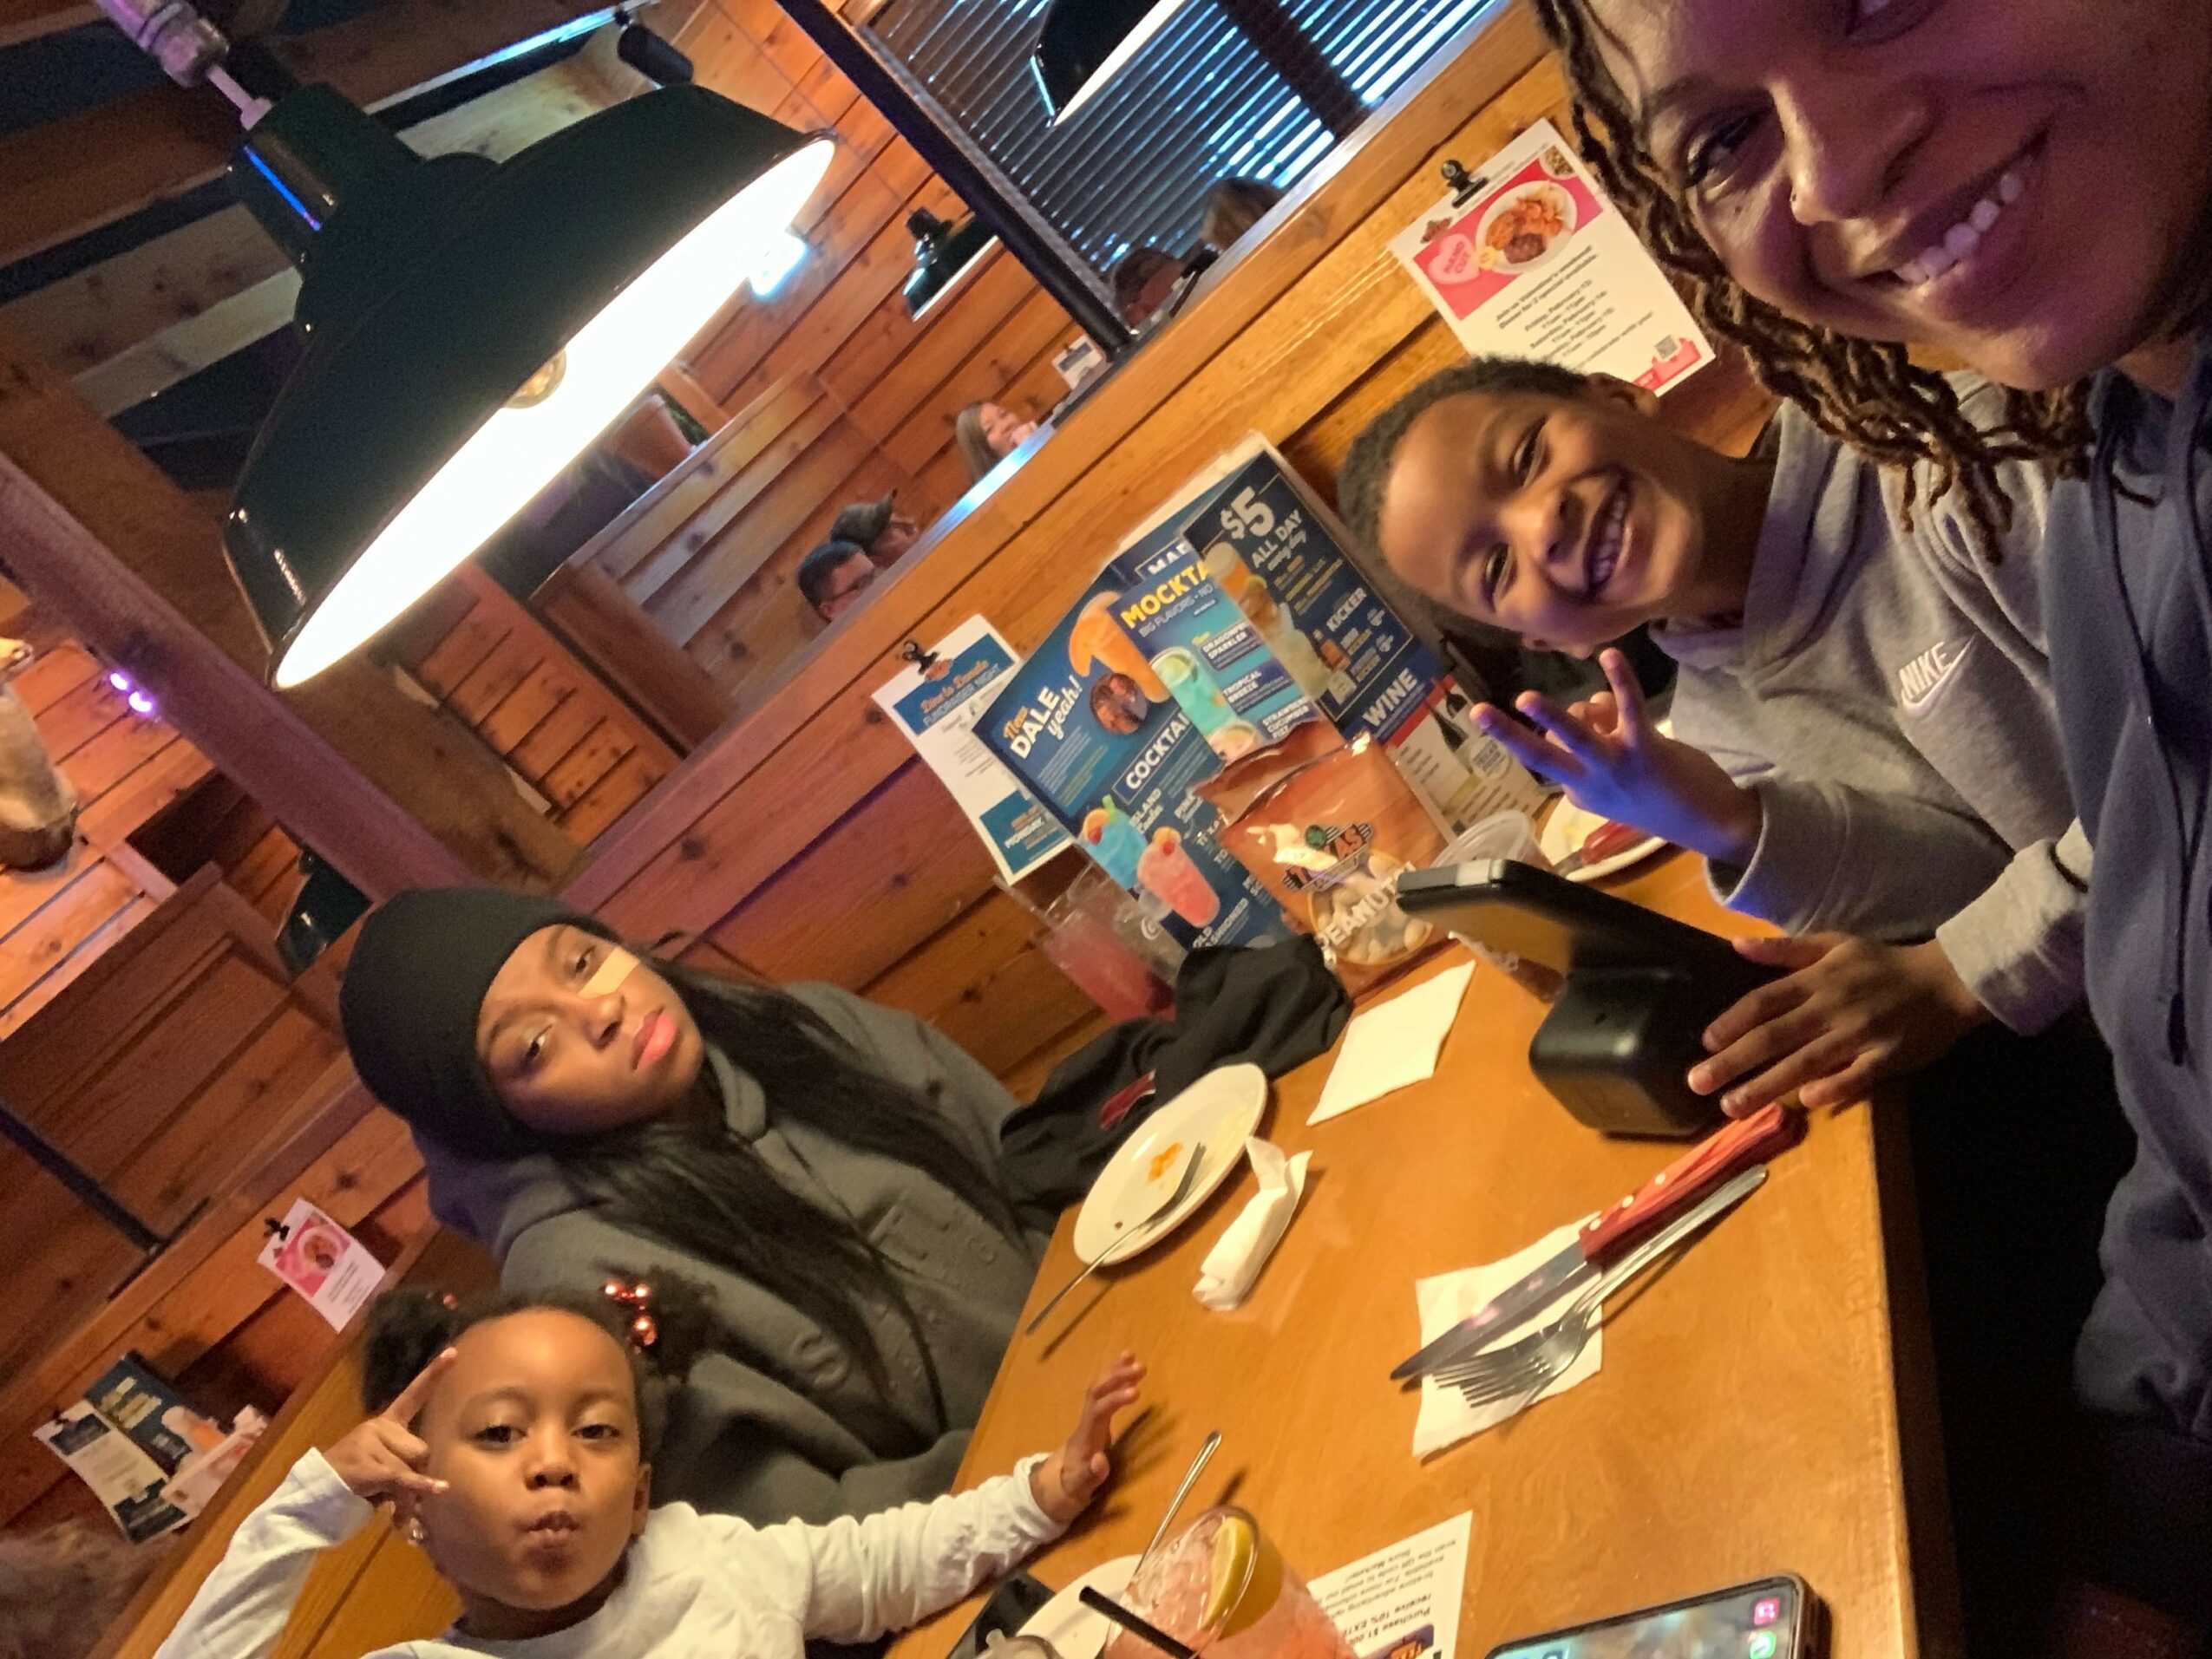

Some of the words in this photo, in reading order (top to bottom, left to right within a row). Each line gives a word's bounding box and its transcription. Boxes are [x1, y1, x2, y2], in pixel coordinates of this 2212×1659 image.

[1218, 484, 1275, 540] $5
[1251, 539, 1279, 568] ALL
[1273, 508, 1302, 541] DAY
[1137, 621, 1156, 638] BIG
[1153, 595, 1195, 627] FLAVORS
[1323, 585, 1370, 632] KICKER
[1207, 630, 1247, 660] SPARKLER
[1898, 641, 1951, 699] NIKE
[1045, 673, 1083, 741] yeah!
[1221, 668, 1262, 698] TROPICAL
[1361, 666, 1418, 726] WINE
[1009, 684, 1061, 759] DALE
[1382, 1606, 1429, 1632] Purchase
[1394, 1593, 1430, 1614] receive
